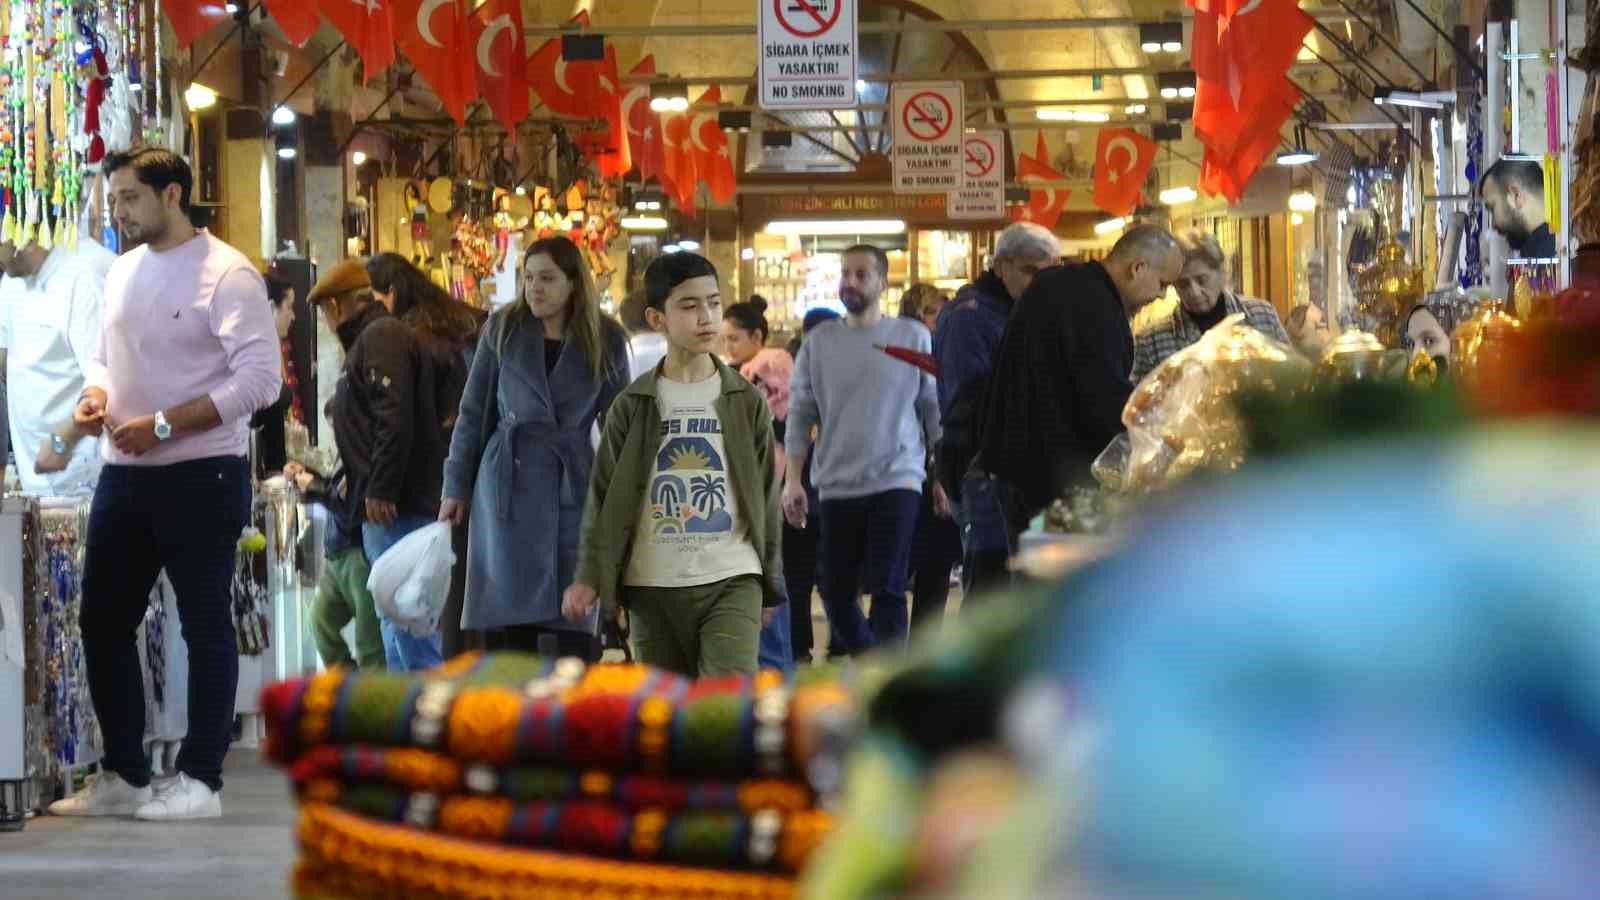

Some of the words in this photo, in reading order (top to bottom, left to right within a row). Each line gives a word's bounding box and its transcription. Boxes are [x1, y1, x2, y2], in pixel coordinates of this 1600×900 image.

[766, 41, 808, 57] SİGARA
[812, 41, 850, 59] İÇMEK
[778, 62, 840, 75] YASAKTIR!
[772, 84, 788, 98] NO
[791, 84, 845, 98] SMOKING
[901, 176, 914, 185] NO
[915, 176, 955, 185] SMOKING
